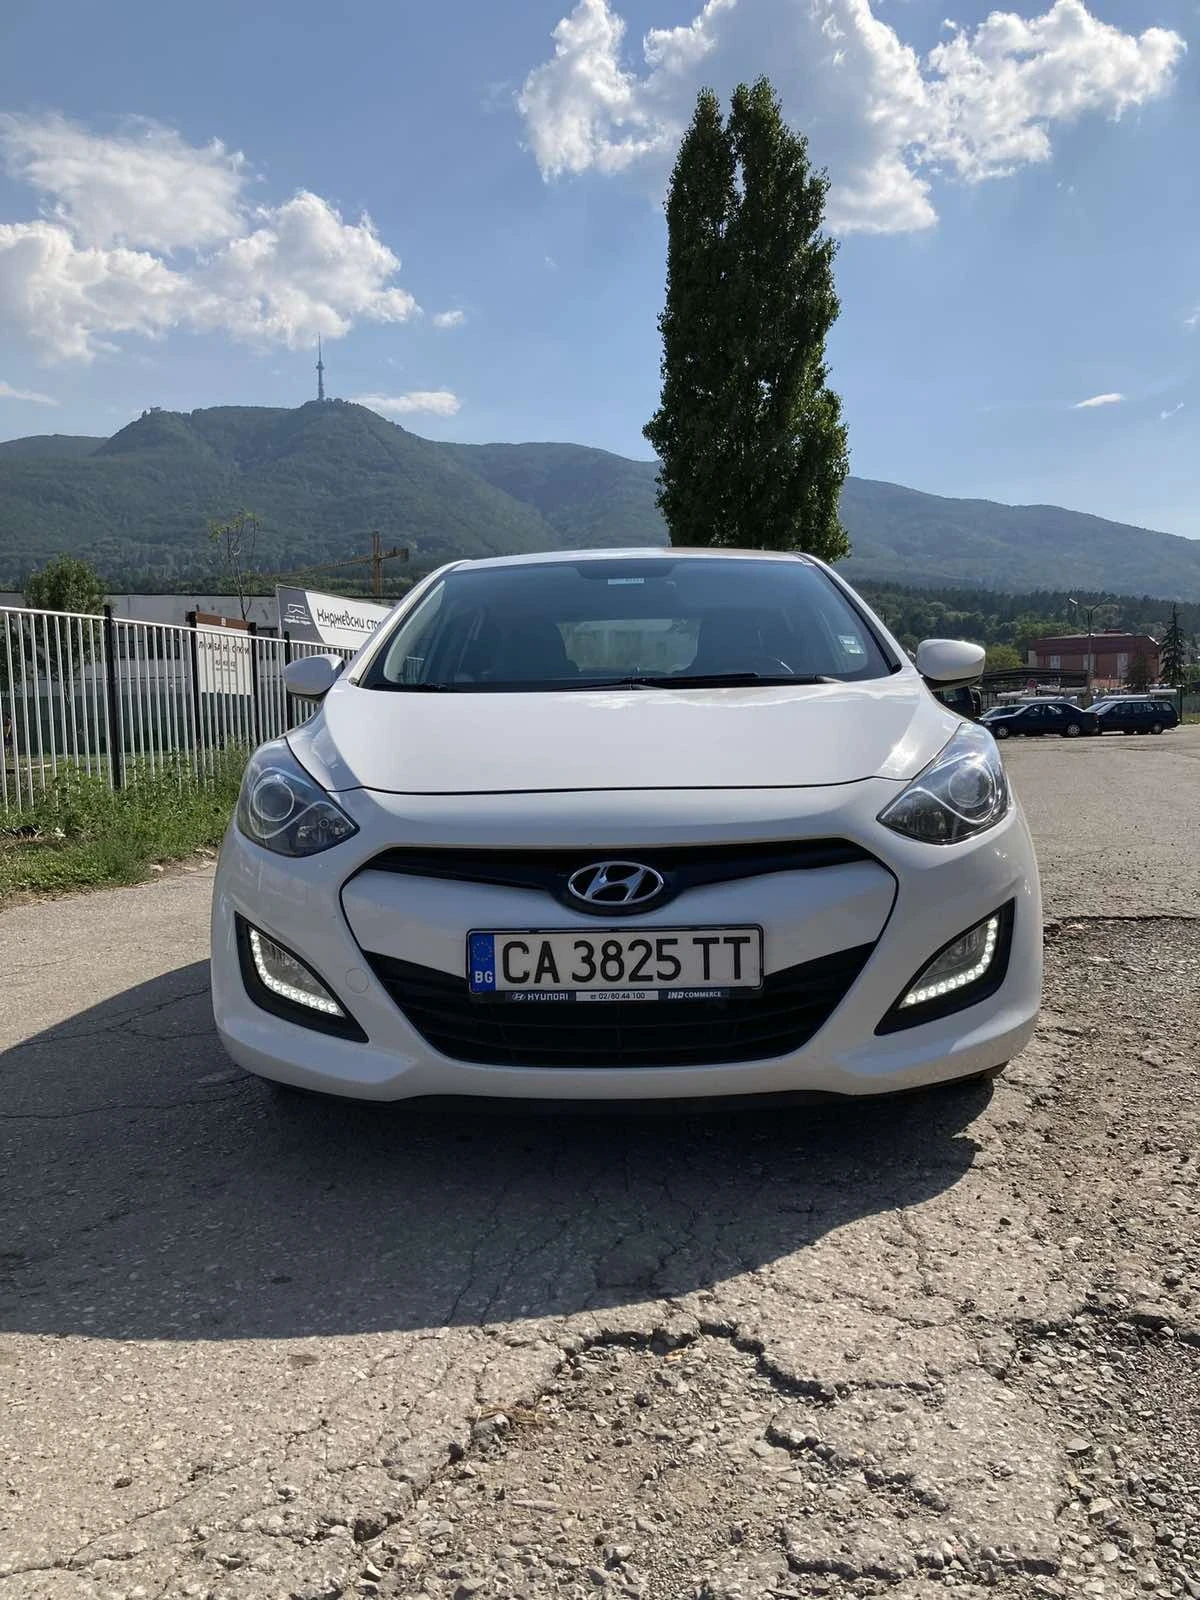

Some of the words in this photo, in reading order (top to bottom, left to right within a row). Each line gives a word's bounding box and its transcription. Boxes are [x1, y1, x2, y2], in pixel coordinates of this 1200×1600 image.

[502, 940, 560, 984] CA
[571, 938, 682, 983] 3825
[692, 936, 751, 981] TT
[474, 970, 493, 984] BG
[527, 992, 569, 1001] HYUNDAI
